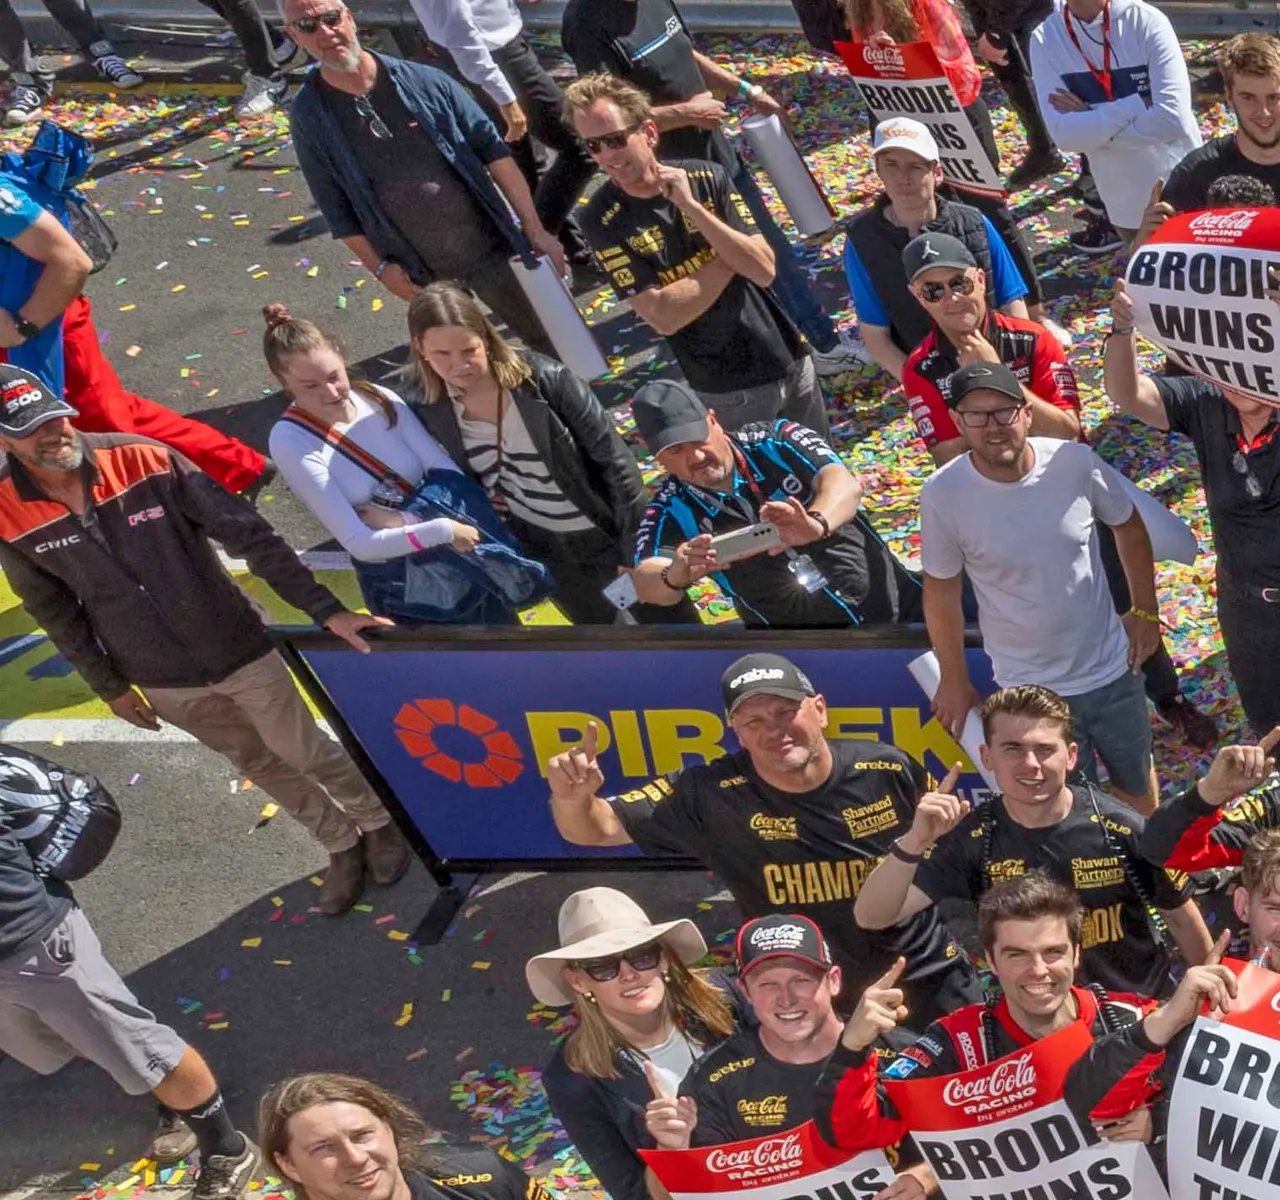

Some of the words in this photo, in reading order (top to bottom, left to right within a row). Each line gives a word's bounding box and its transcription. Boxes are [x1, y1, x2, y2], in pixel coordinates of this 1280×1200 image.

[859, 83, 960, 114] BRODIE
[1189, 211, 1260, 230] Coca-Cola
[1149, 303, 1274, 353] WINS
[35, 535, 80, 553] CIVIC
[854, 760, 903, 772] erebus
[842, 795, 892, 822] Shawand
[846, 809, 897, 831] Partners
[751, 924, 806, 945] Coca-Cola
[709, 1058, 756, 1082] erebus
[943, 1051, 1037, 1106] Coca-Cola
[964, 1087, 1037, 1115] RACING
[705, 1133, 803, 1173] Coca-Cola
[728, 1159, 803, 1180] RACING
